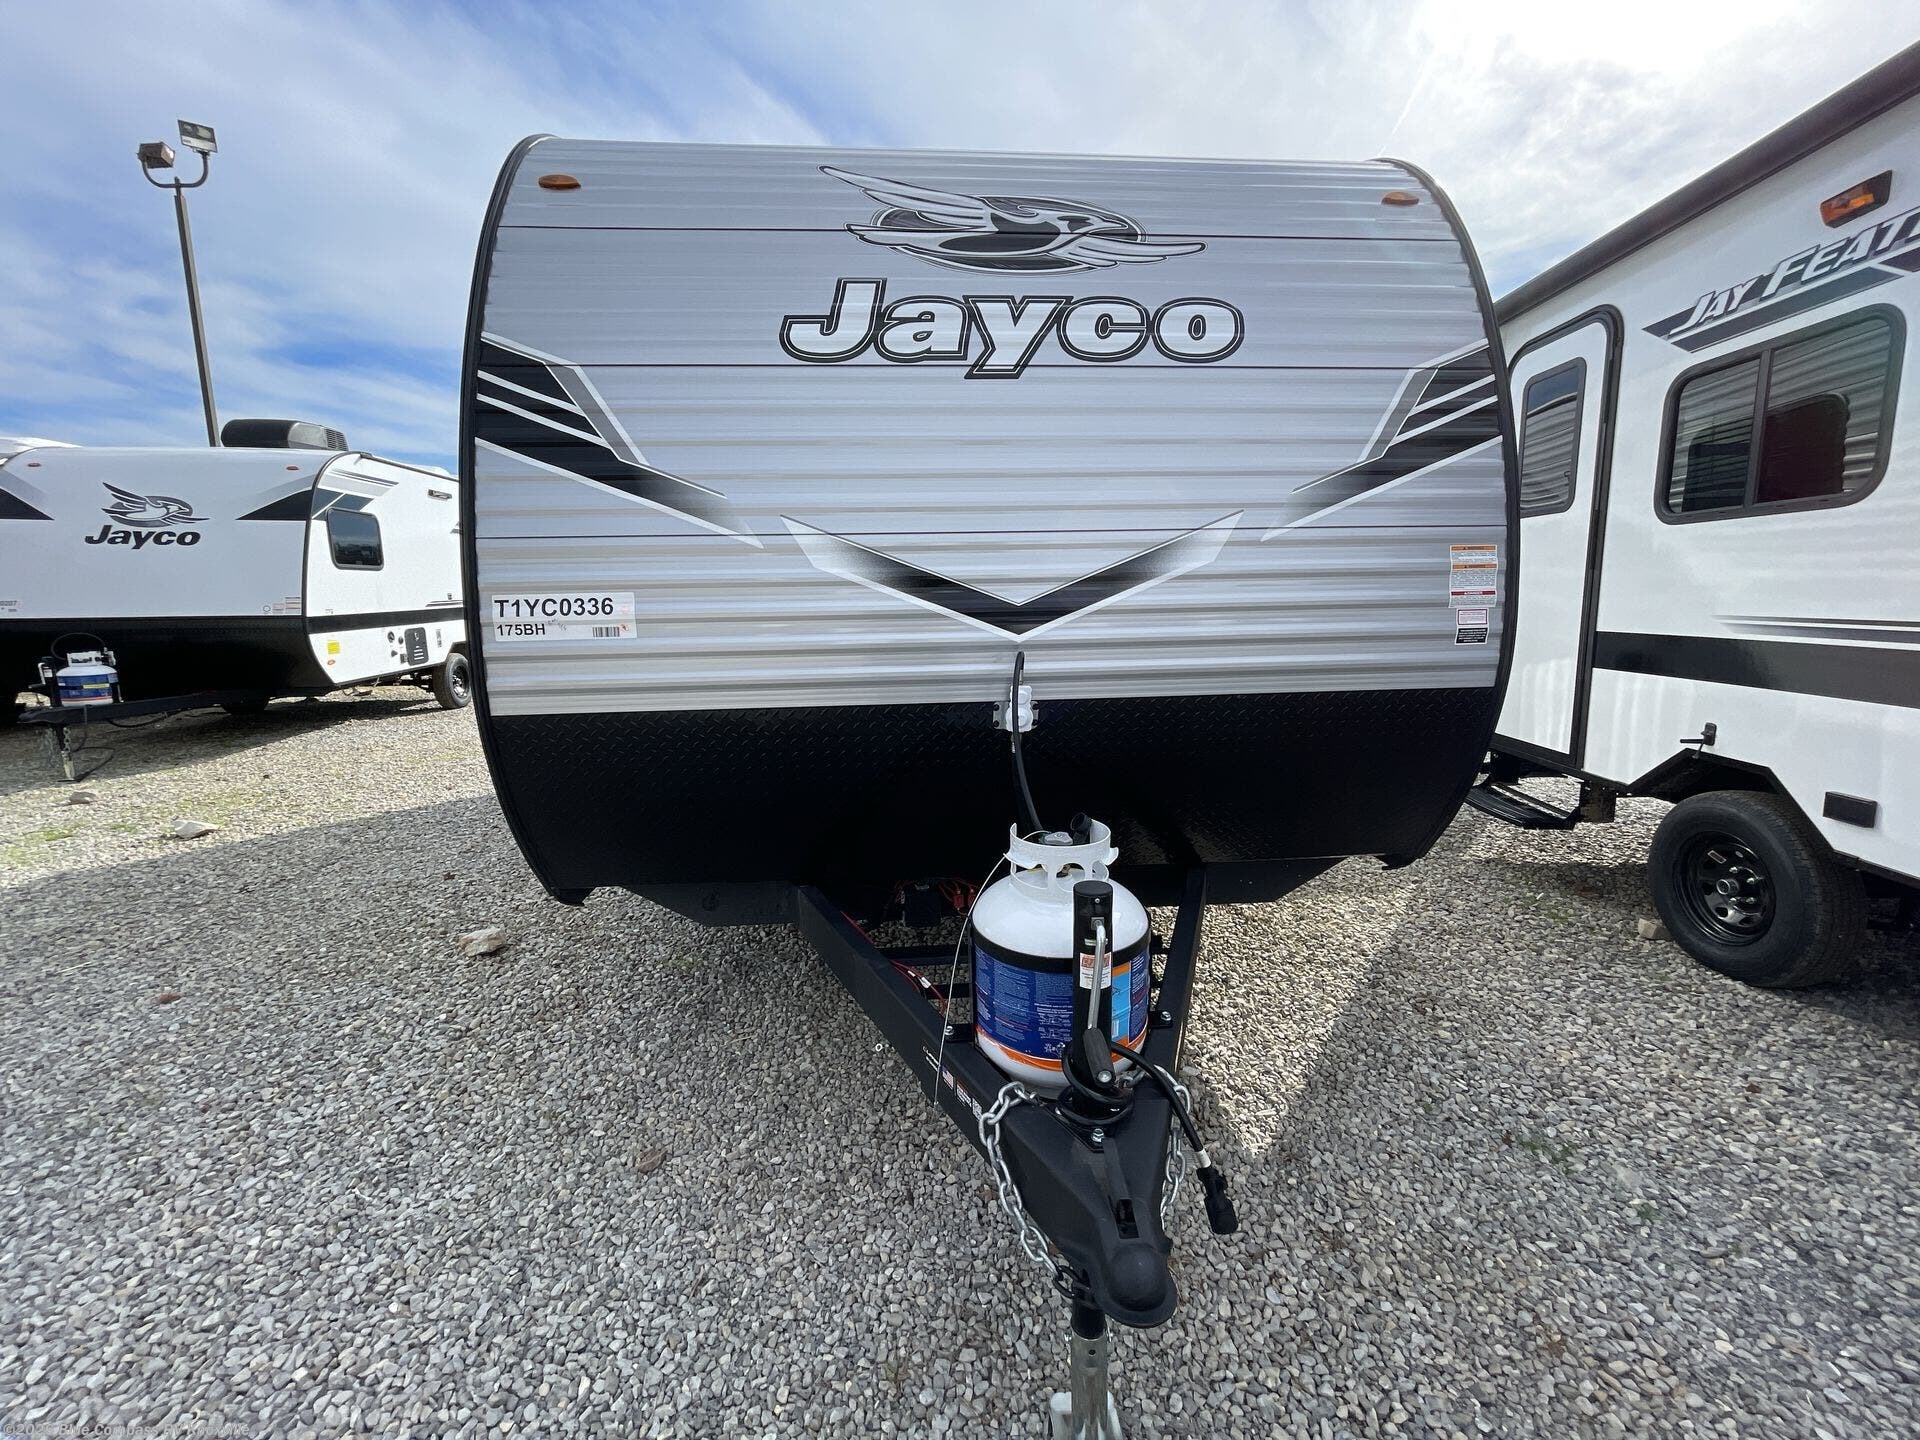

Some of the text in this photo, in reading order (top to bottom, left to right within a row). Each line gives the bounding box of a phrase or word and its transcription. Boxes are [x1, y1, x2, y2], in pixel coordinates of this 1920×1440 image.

[1667, 206, 1920, 338] JAY FEAT
[779, 277, 1245, 380] Jayco
[84, 524, 201, 550] Jayco
[494, 597, 614, 617] T1YC0336
[496, 623, 546, 636] 175BH
